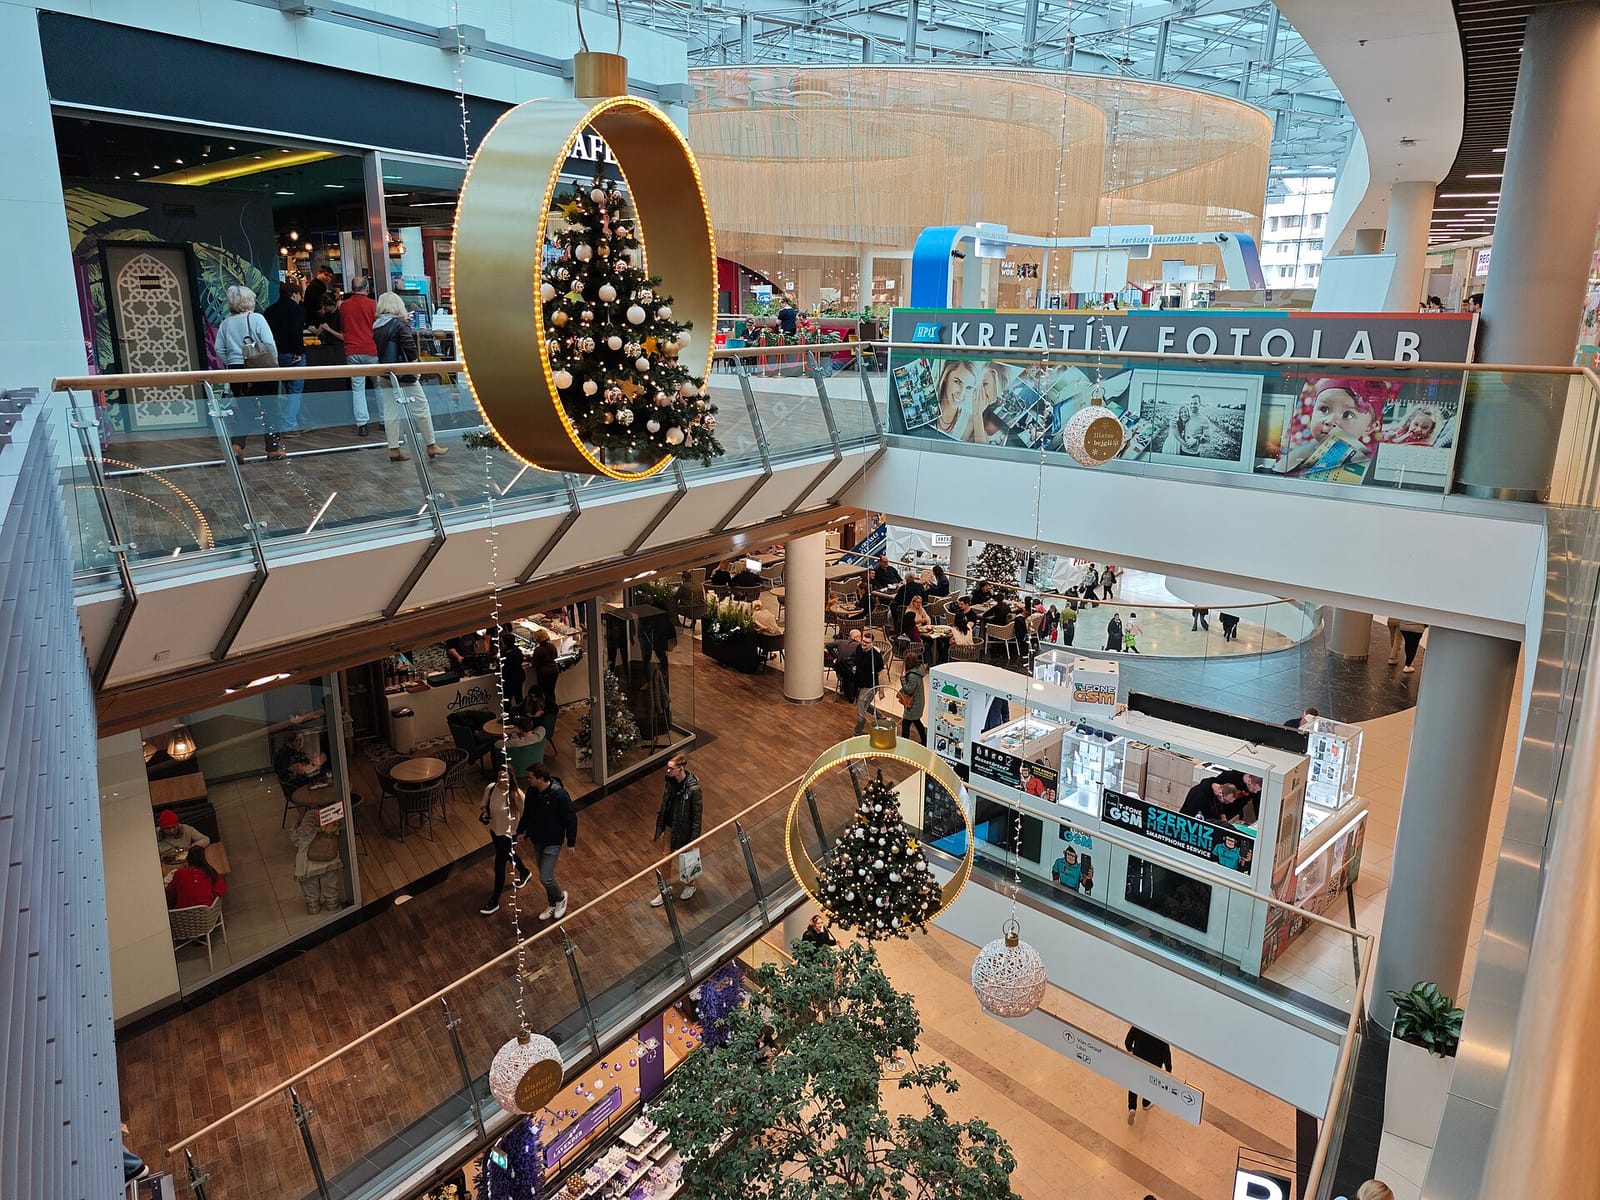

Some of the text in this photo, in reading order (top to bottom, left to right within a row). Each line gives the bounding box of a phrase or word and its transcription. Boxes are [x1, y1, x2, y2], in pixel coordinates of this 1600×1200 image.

[951, 316, 1421, 367] KREATÍV FOTOLAB
[1073, 690, 1116, 705] GSM
[1109, 807, 1143, 828] GSM
[1118, 803, 1143, 816] T-FONE
[1147, 806, 1214, 840] SZERVIZ
[1064, 831, 1092, 849] GSM
[1146, 818, 1213, 850] HELYBEN!
[1146, 829, 1212, 858] SMARTPHONE SERVICE
[553, 1130, 583, 1158] LAVENDER
